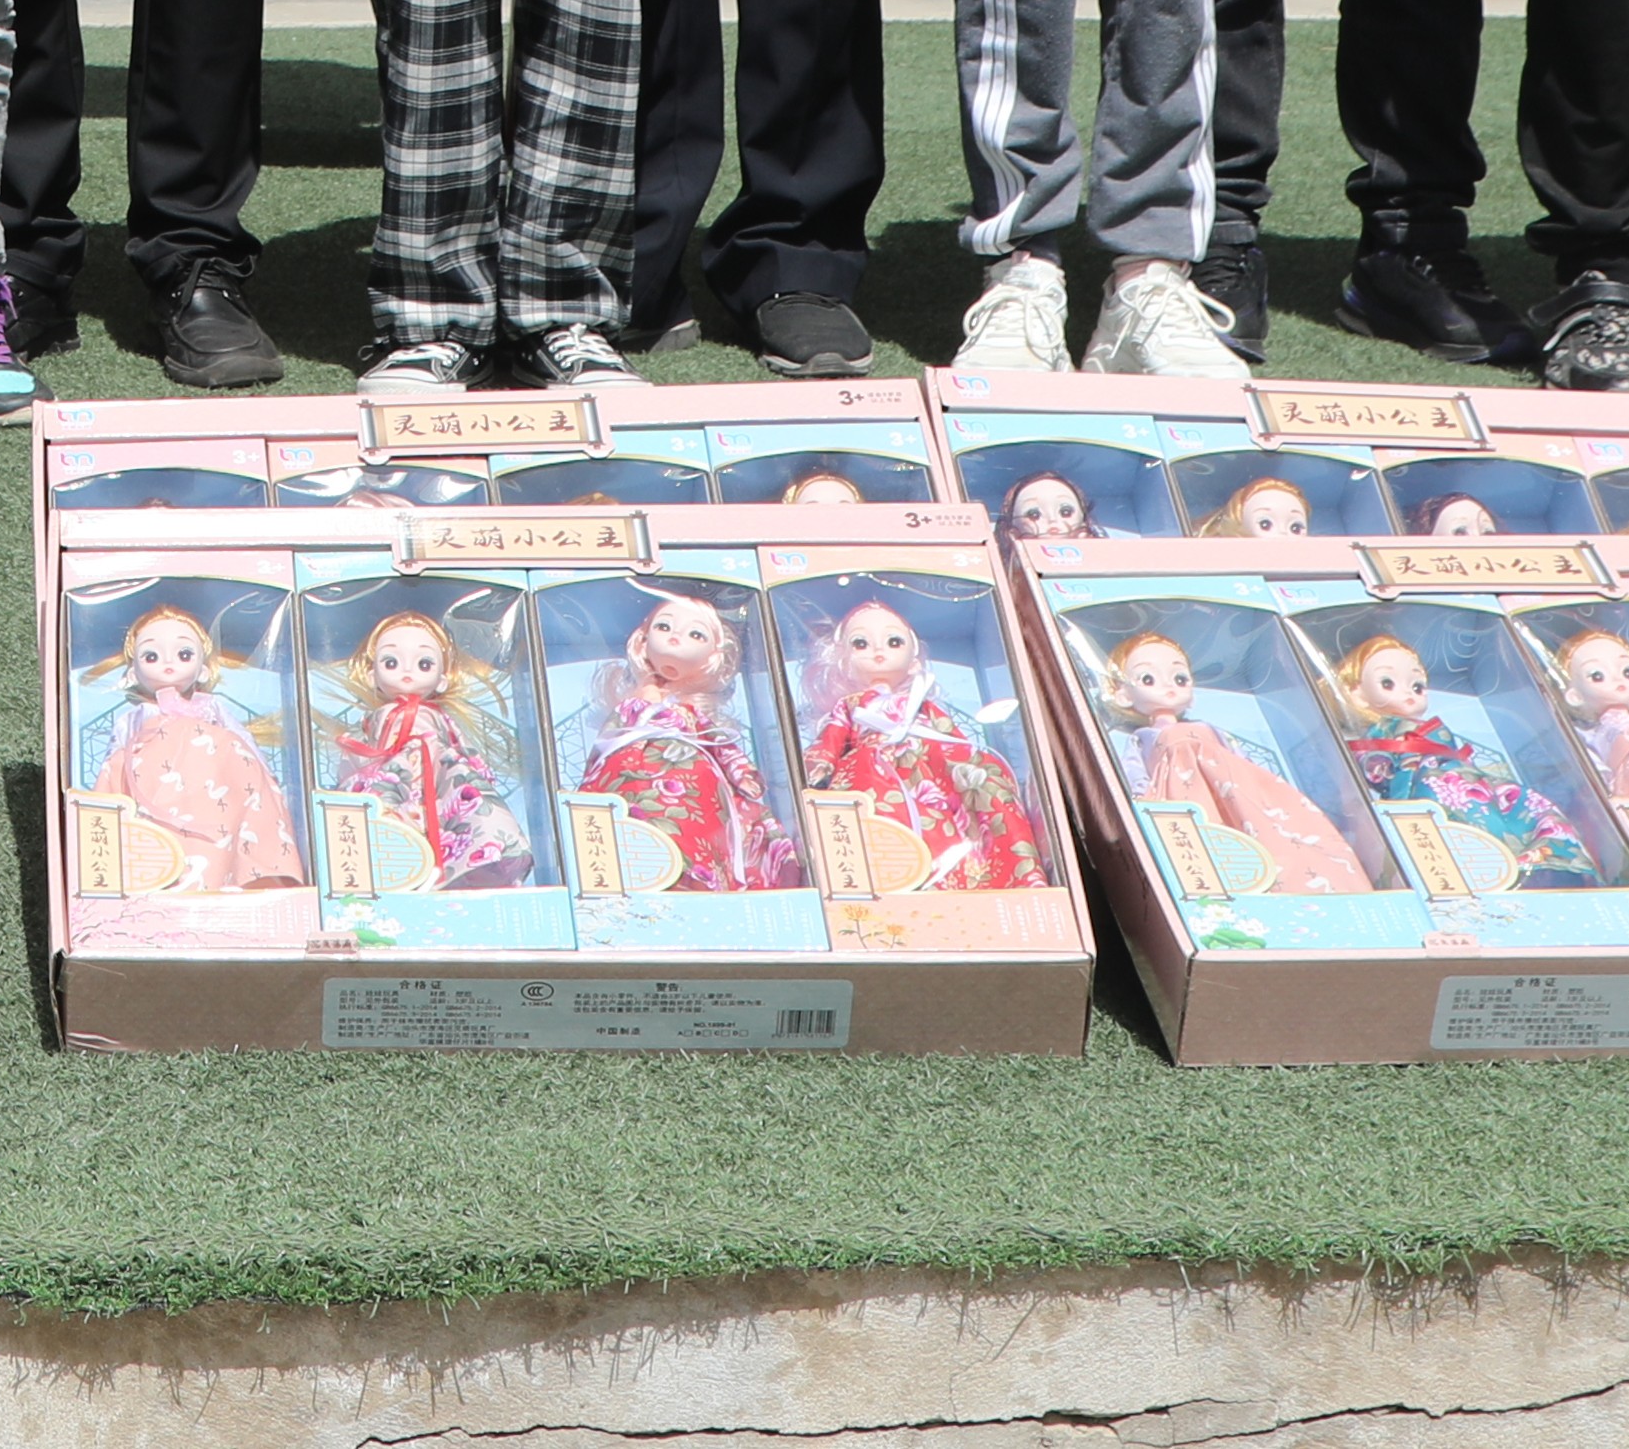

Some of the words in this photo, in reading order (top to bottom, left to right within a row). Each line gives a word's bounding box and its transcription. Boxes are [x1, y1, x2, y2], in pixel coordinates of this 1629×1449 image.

[839, 389, 865, 405] 3+
[393, 409, 576, 437] 灵萌小公主
[1280, 400, 1458, 429] 灵萌小公主
[670, 437, 698, 451] 3+
[889, 432, 918, 446] 3+
[233, 450, 261, 464] 3+
[904, 512, 933, 528] 3+
[431, 525, 625, 550] 灵萌小公主
[1392, 554, 1583, 577] 灵萌小公主
[90, 812, 117, 892] 灵萌小公主
[337, 811, 365, 892] 灵萌小公主
[582, 815, 610, 894] 灵萌小公主
[826, 813, 860, 892] 灵萌小公主
[1168, 817, 1216, 892] 灵萌小公主
[1407, 819, 1460, 894] 灵萌小公主
[399, 979, 443, 990] 合格证
[1514, 977, 1557, 988] 合格证
[596, 1027, 641, 1036] 中国制造
